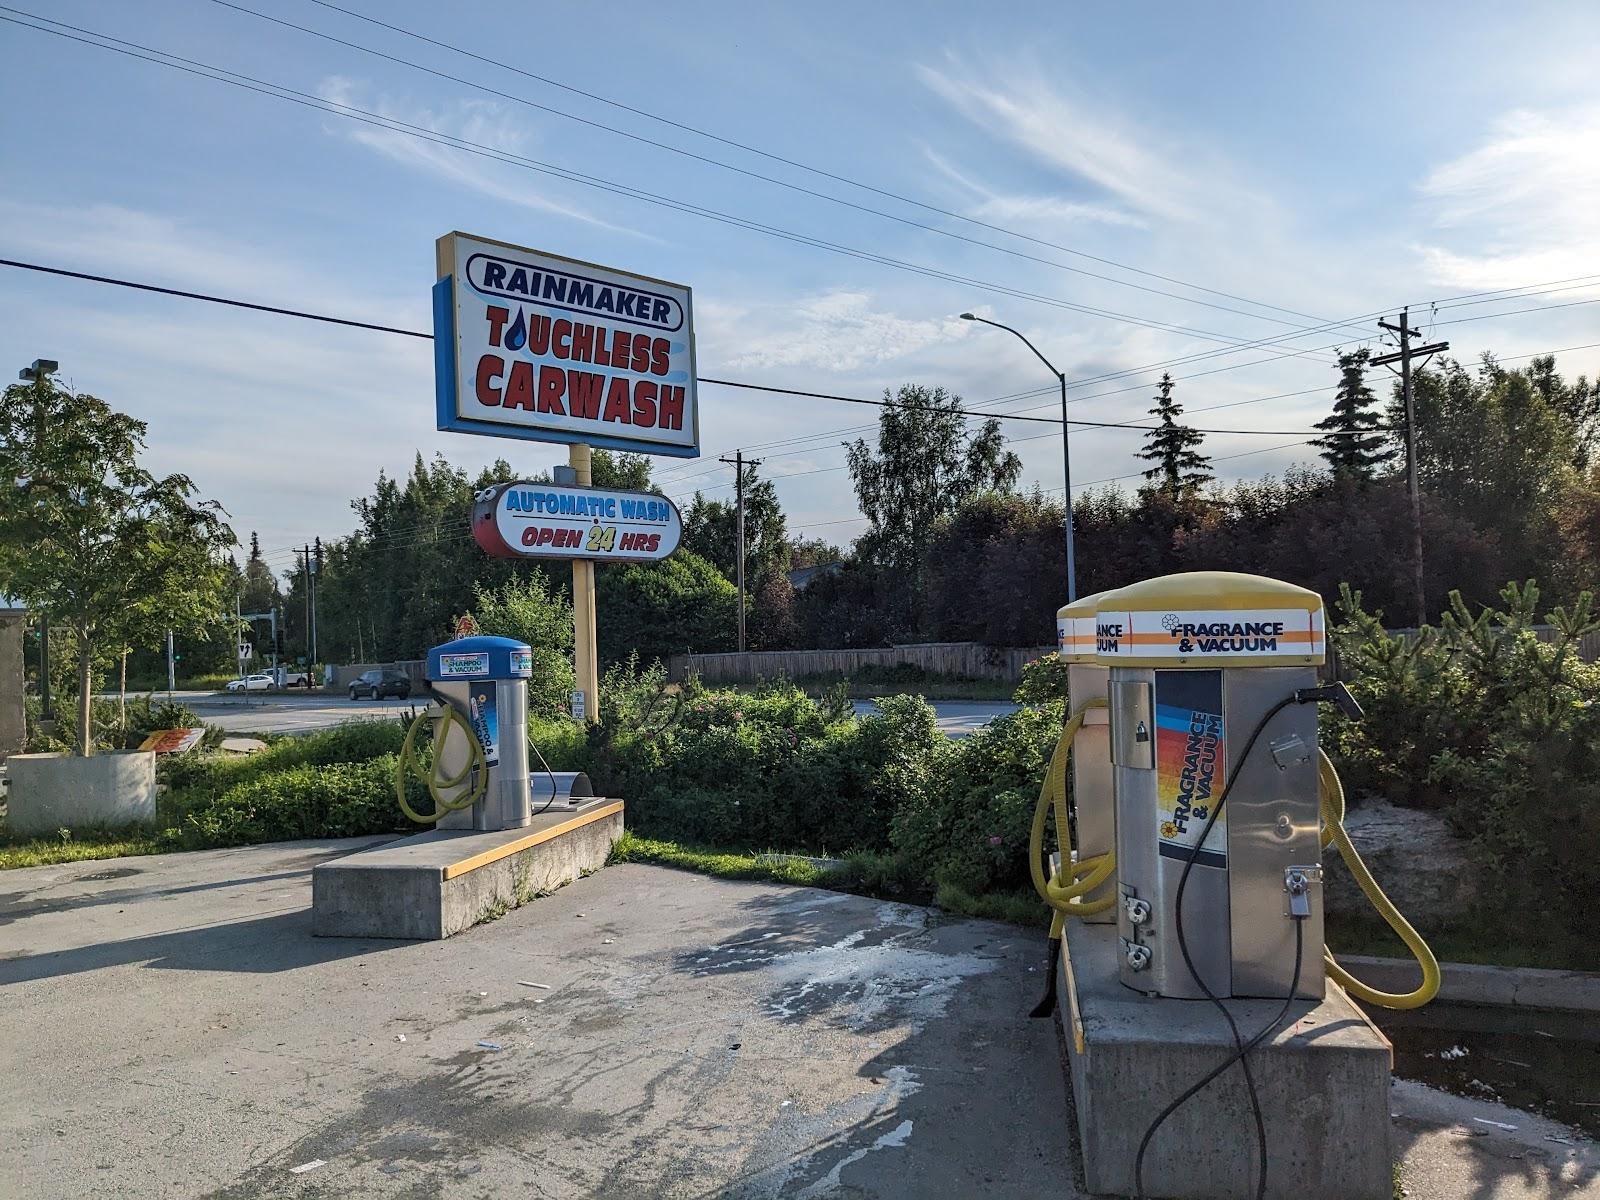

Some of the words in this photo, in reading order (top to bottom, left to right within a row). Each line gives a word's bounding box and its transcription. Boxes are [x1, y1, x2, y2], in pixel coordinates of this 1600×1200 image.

[483, 261, 671, 324] RAINMAKER
[475, 354, 686, 431] CARWASH
[506, 490, 616, 518] AUTOMATIC
[620, 500, 670, 522] WASH
[521, 526, 583, 548] OPEN
[586, 525, 616, 552] 24
[619, 532, 662, 552] HRS
[1171, 622, 1284, 637] FRAGRANCE
[1178, 639, 1194, 652] &
[1197, 637, 1277, 652] VACUUM
[449, 660, 482, 668] SHAMPOO
[1195, 714, 1223, 801] VACUUM
[1172, 711, 1208, 834] FRAGRANCE
[1192, 807, 1208, 820] &
